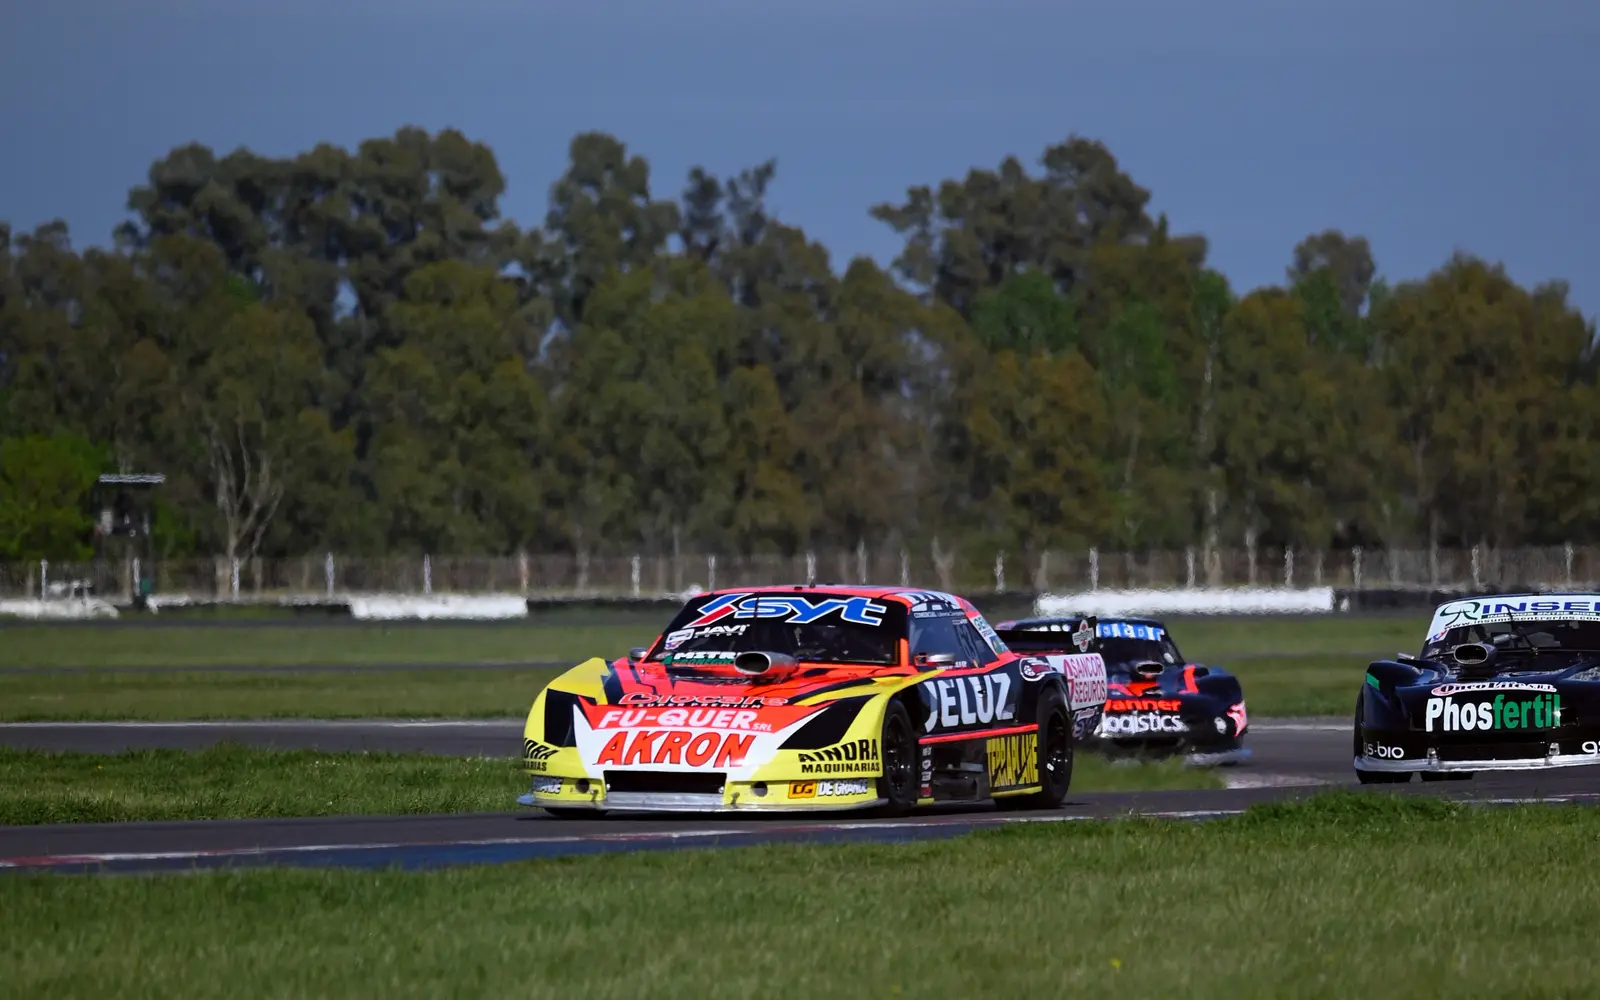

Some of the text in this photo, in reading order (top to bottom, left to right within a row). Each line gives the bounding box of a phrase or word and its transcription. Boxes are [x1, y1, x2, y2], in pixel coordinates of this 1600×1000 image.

[673, 651, 743, 661] MITR
[1070, 656, 1104, 680] SANCOR
[1074, 680, 1106, 704] SEGUROS
[597, 708, 773, 732] FU-QUER SRL
[1425, 693, 1561, 732] Phosfertil
[592, 730, 757, 768] AKRON
[801, 762, 880, 774] MAQUINARIAS
